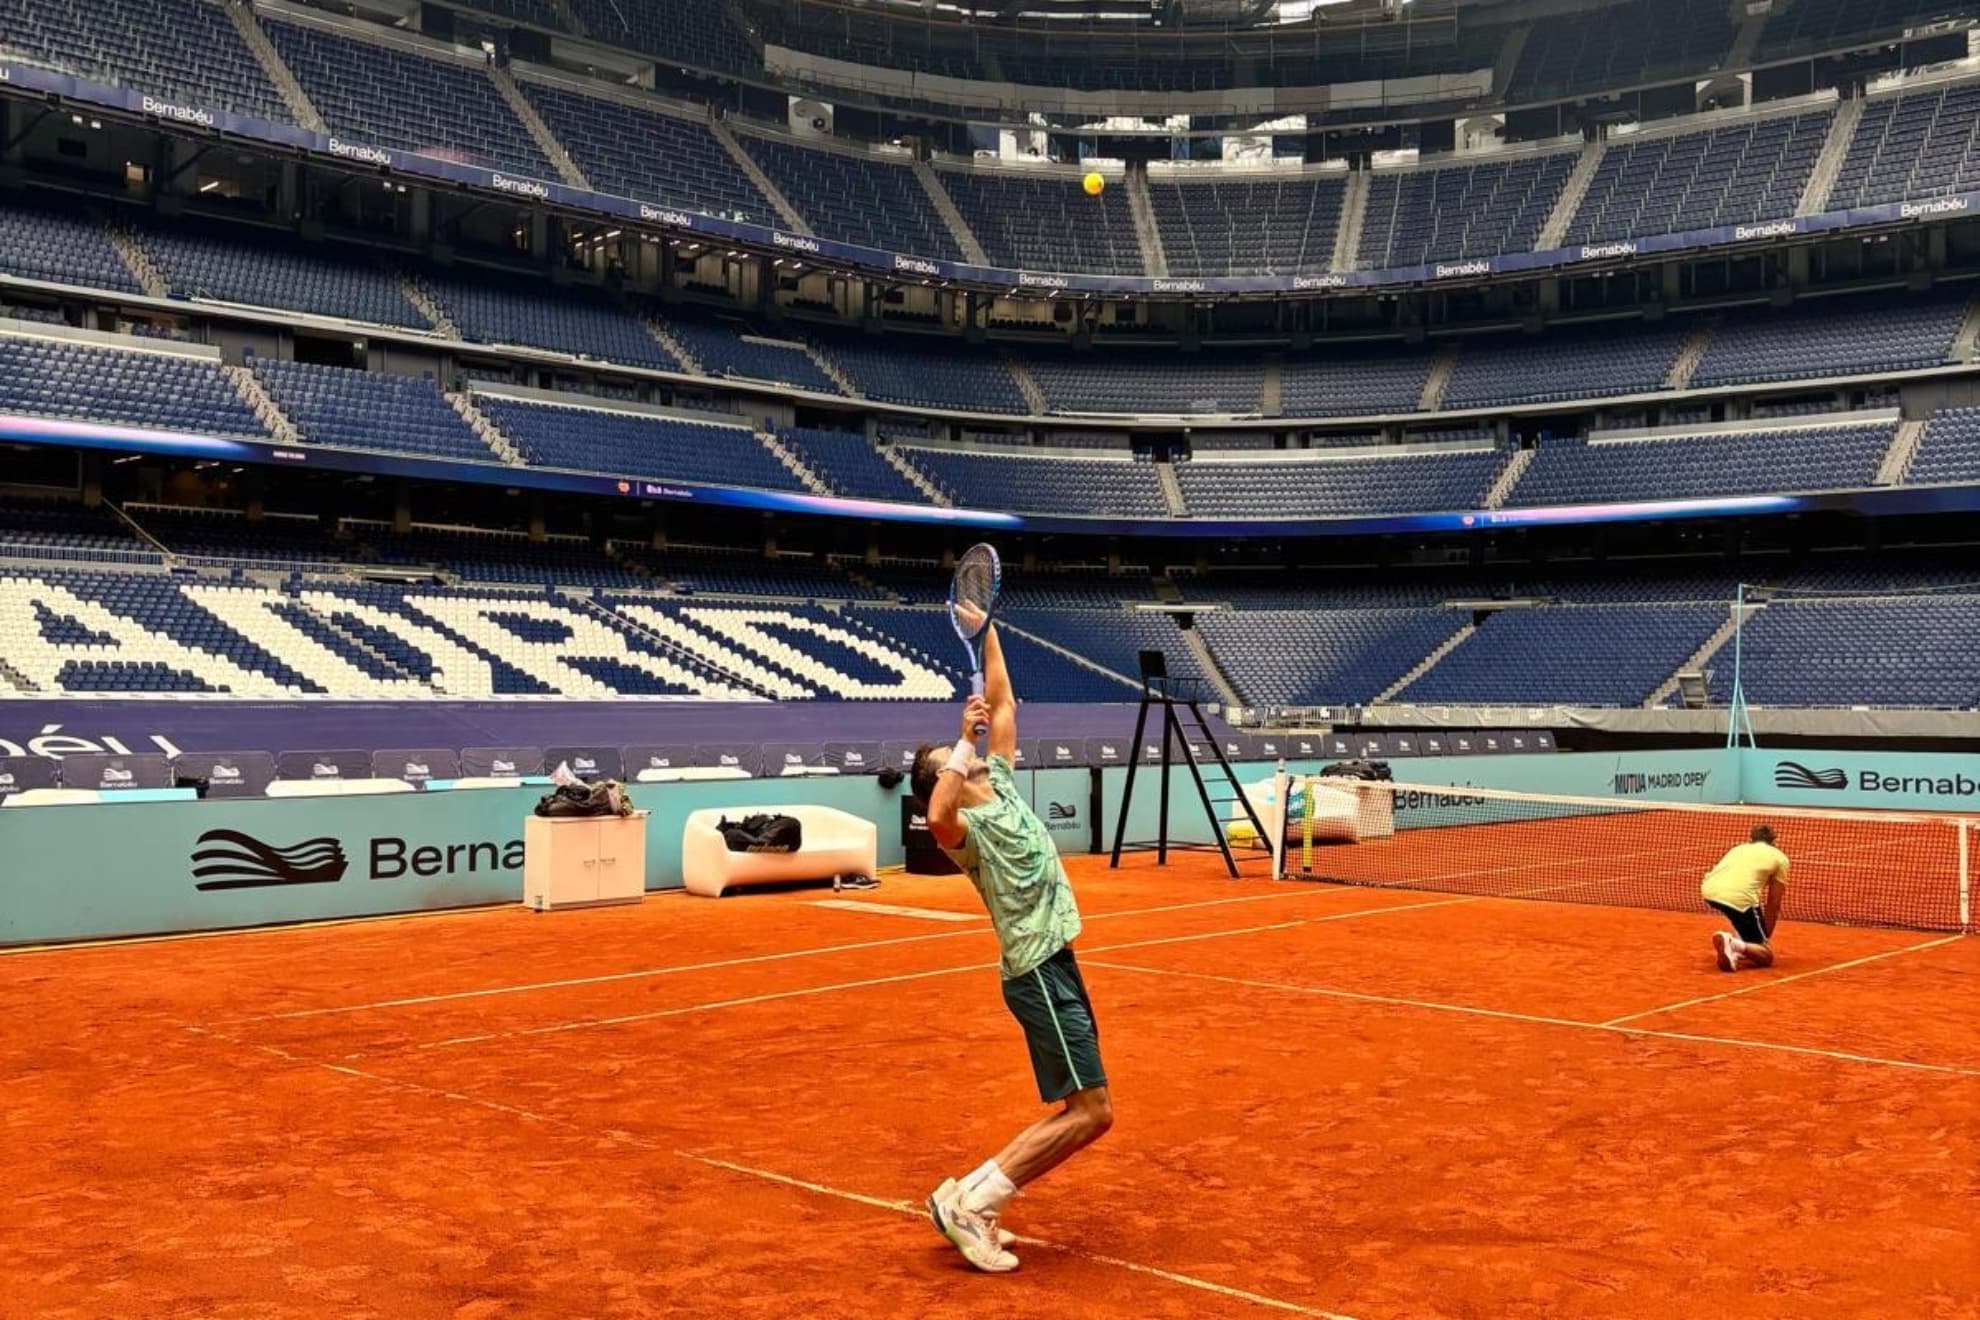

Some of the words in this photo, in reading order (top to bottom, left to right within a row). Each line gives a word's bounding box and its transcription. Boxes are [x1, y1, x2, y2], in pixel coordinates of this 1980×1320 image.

[143, 96, 214, 125] Bernabéu
[328, 138, 391, 164] Bernabéu
[492, 174, 549, 198] Bernabéu
[640, 205, 692, 226] Bernabéu
[1900, 198, 1968, 218] Bernabéu
[1735, 222, 1797, 240] Bernabéu
[1581, 242, 1637, 259] Bernabéu
[1436, 261, 1489, 277] Bernabéu
[1153, 279, 1205, 291] Bernabéu
[1293, 276, 1346, 289] Bernabéu
[1615, 773, 1647, 795] MUTUA
[1648, 772, 1681, 789] MADRID
[1683, 770, 1708, 787] OPEN
[1860, 771, 1980, 796] Bernab
